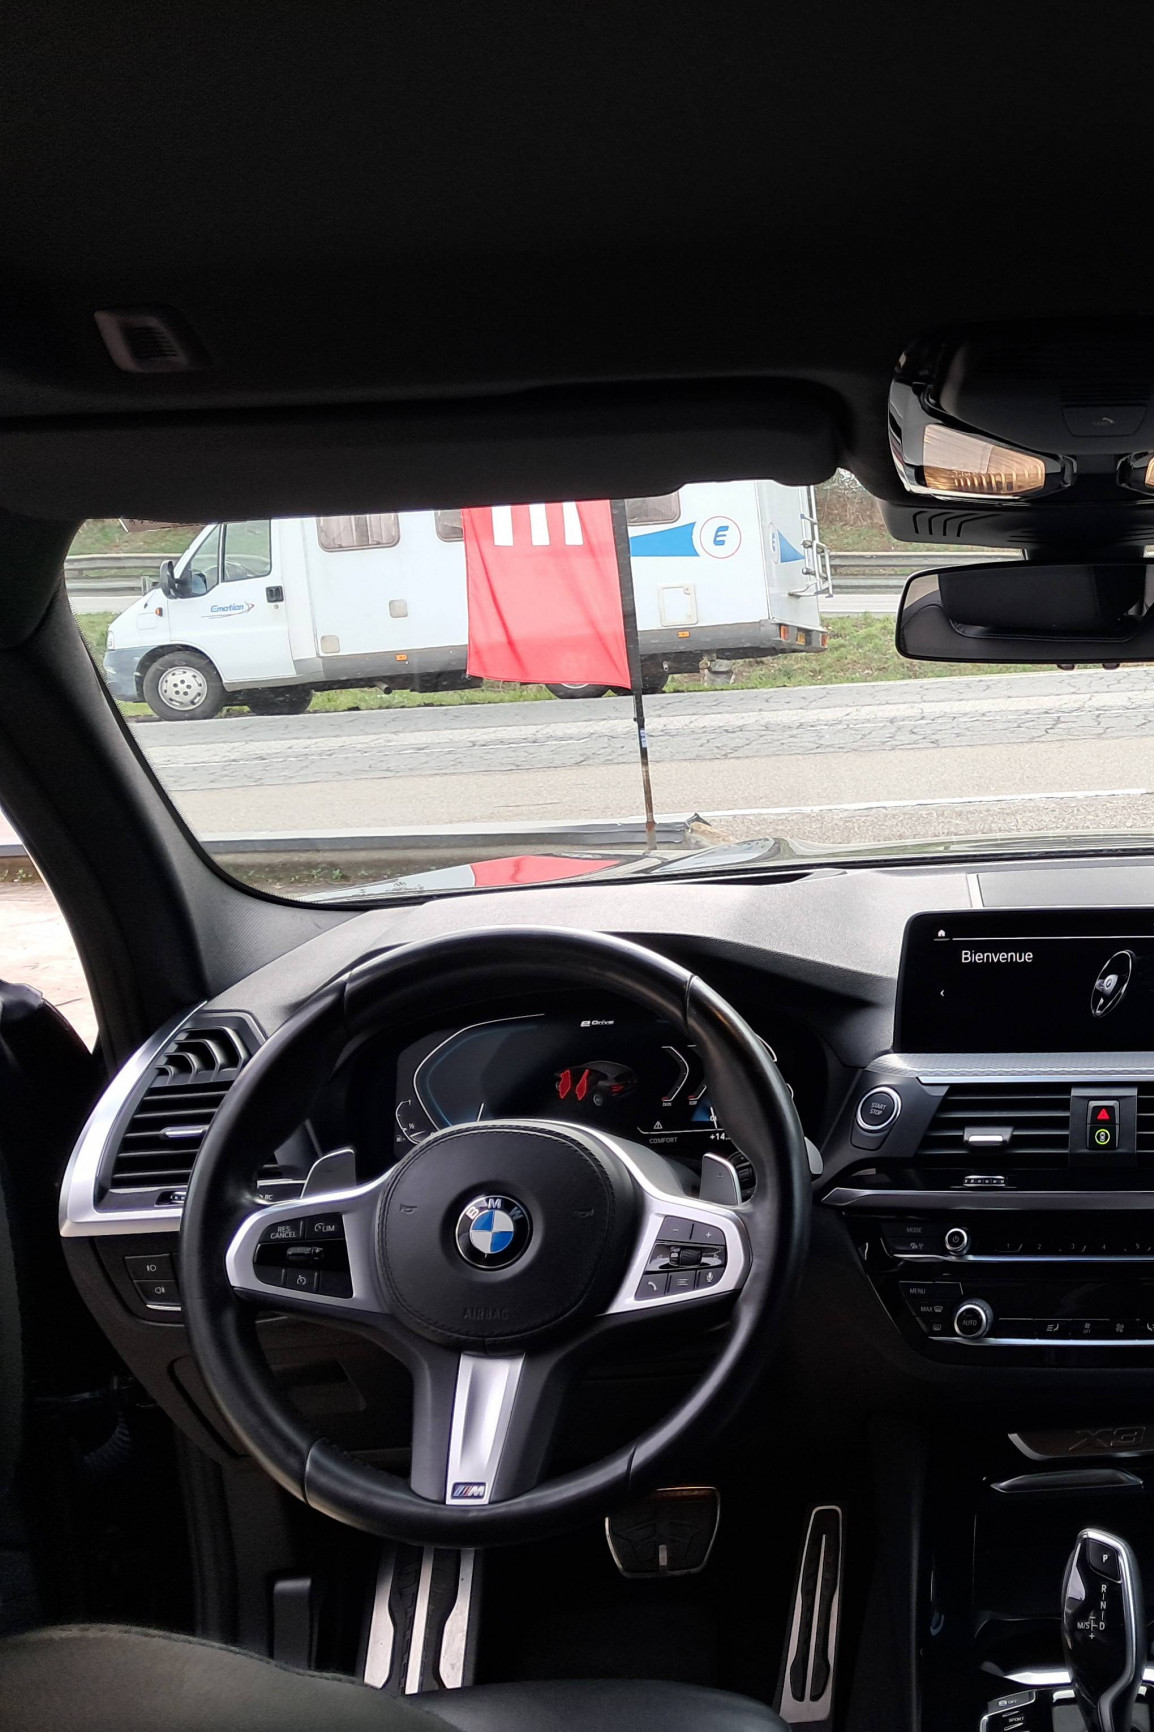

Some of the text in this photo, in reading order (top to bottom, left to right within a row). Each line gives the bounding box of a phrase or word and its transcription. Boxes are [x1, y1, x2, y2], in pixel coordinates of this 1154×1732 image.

[713, 525, 729, 546] E
[210, 603, 245, 613] Emotion
[961, 949, 1034, 963] Bienvenue
[870, 1102, 887, 1110] START
[465, 1198, 524, 1221] BMW
[322, 1224, 335, 1232] LIM
[270, 1231, 297, 1239] CANCEL
[909, 1287, 927, 1295] MENU
[463, 1307, 509, 1320] AIRBAG
[962, 1319, 979, 1327] AUTO
[1102, 1553, 1109, 1563] P
[1101, 1583, 1107, 1593] R
[1100, 1600, 1107, 1610] N
[1099, 1621, 1106, 1631] D
